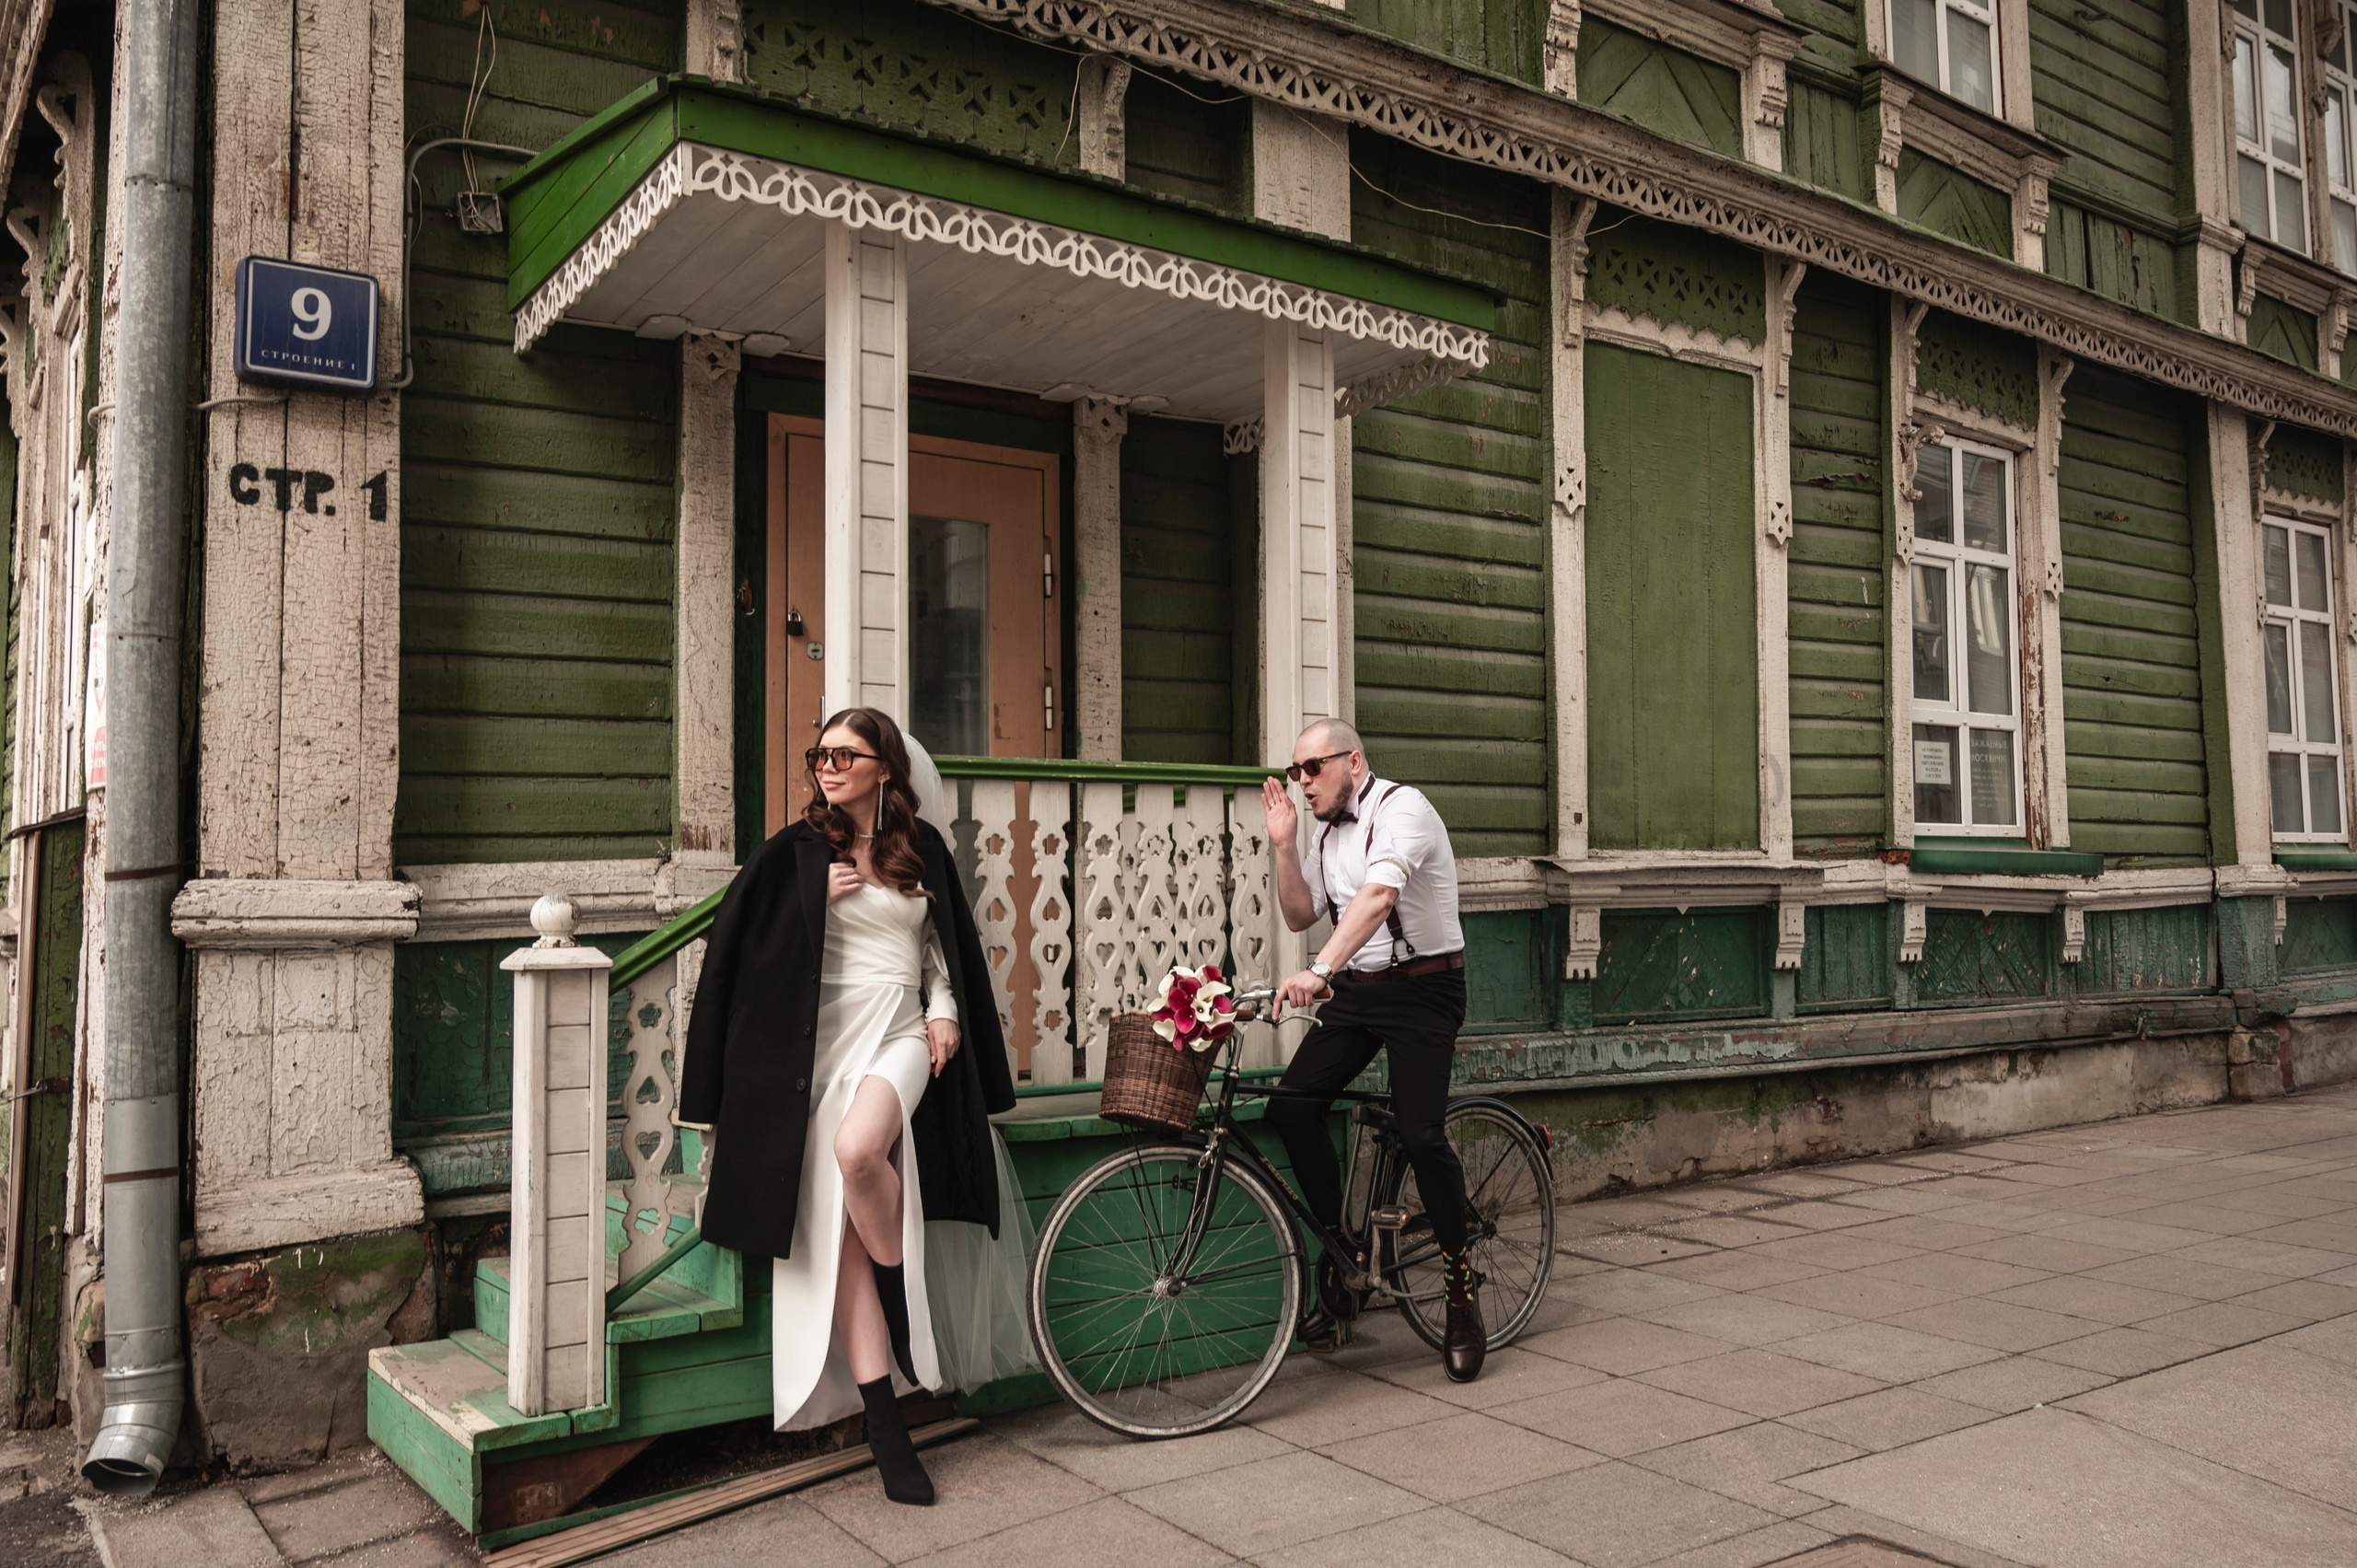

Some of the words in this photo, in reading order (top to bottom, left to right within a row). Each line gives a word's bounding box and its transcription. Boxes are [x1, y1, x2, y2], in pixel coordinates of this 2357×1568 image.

[291, 287, 331, 341] 9
[261, 350, 344, 368] СТРОЕНИЕ
[230, 462, 336, 516] СТР.
[360, 470, 388, 522] 1
[1970, 738, 2007, 749] ВАЖАЕМЫЕ
